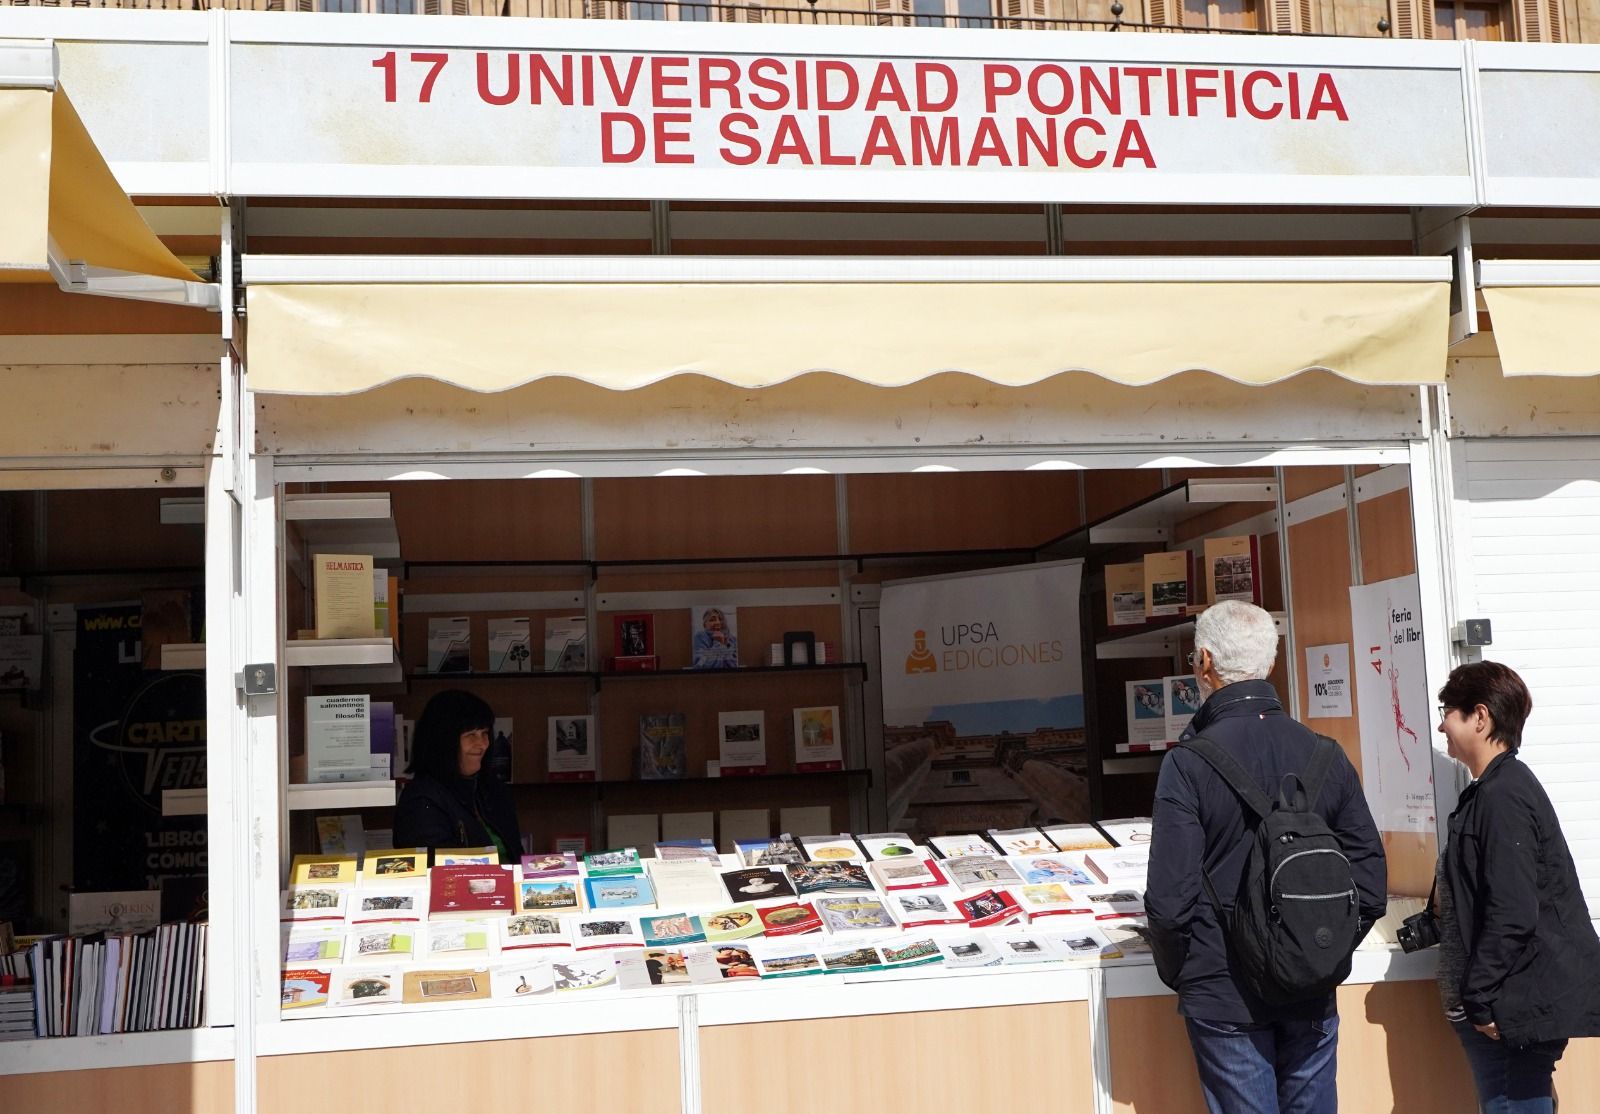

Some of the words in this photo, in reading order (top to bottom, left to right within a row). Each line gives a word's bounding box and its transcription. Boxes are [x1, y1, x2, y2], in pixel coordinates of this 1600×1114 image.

[373, 51, 448, 103] 17
[477, 53, 959, 113] UNIVERSIDAD
[984, 64, 1348, 121] PONTIFICIA
[601, 111, 695, 165] DE
[720, 111, 1156, 169] SALAMANCA
[1391, 608, 1412, 623] feria
[941, 622, 999, 646] UPSA
[1393, 629, 1405, 644] del
[943, 640, 1063, 671] EDICIONES
[1314, 682, 1328, 696] 10%
